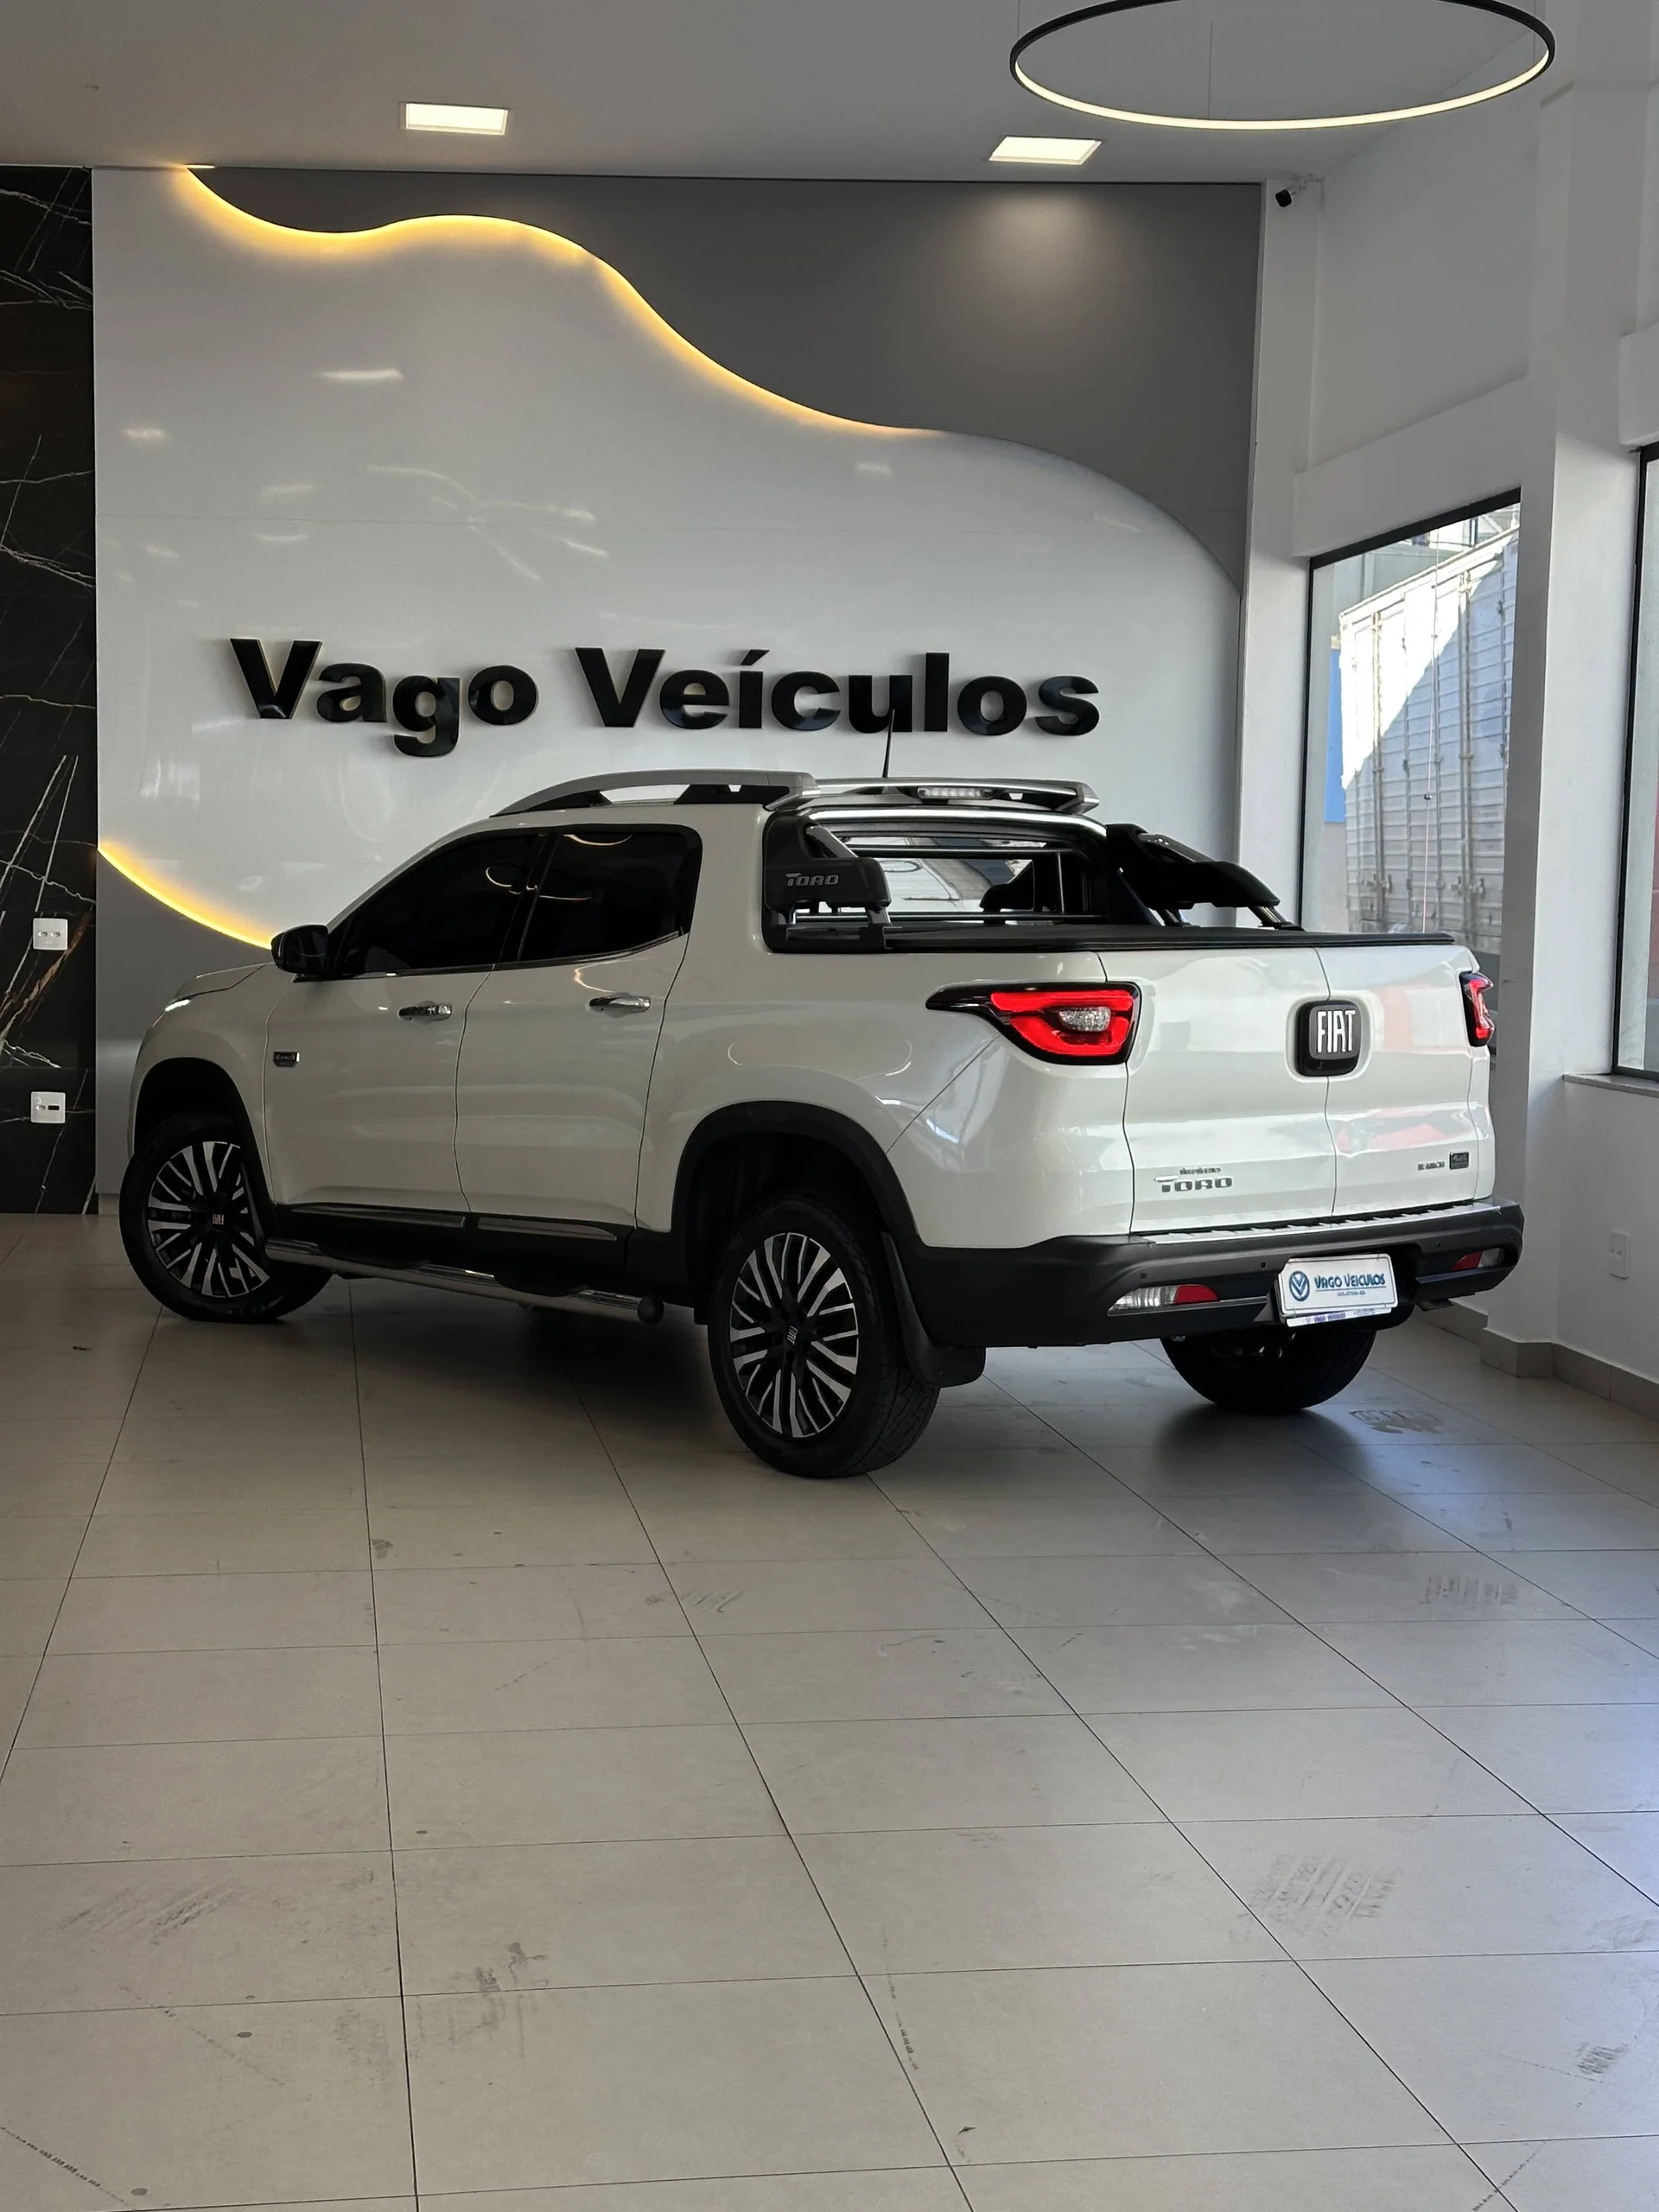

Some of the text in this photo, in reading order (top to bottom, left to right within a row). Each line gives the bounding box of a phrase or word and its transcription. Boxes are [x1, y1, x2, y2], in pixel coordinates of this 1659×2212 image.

[229, 638, 1101, 757] Vago Veículos
[785, 872, 840, 887] TORO
[1317, 1009, 1357, 1053] FIAT
[1154, 1175, 1233, 1193] TORO
[1314, 1274, 1343, 1289] VAGO
[787, 1325, 798, 1345] FIAT
